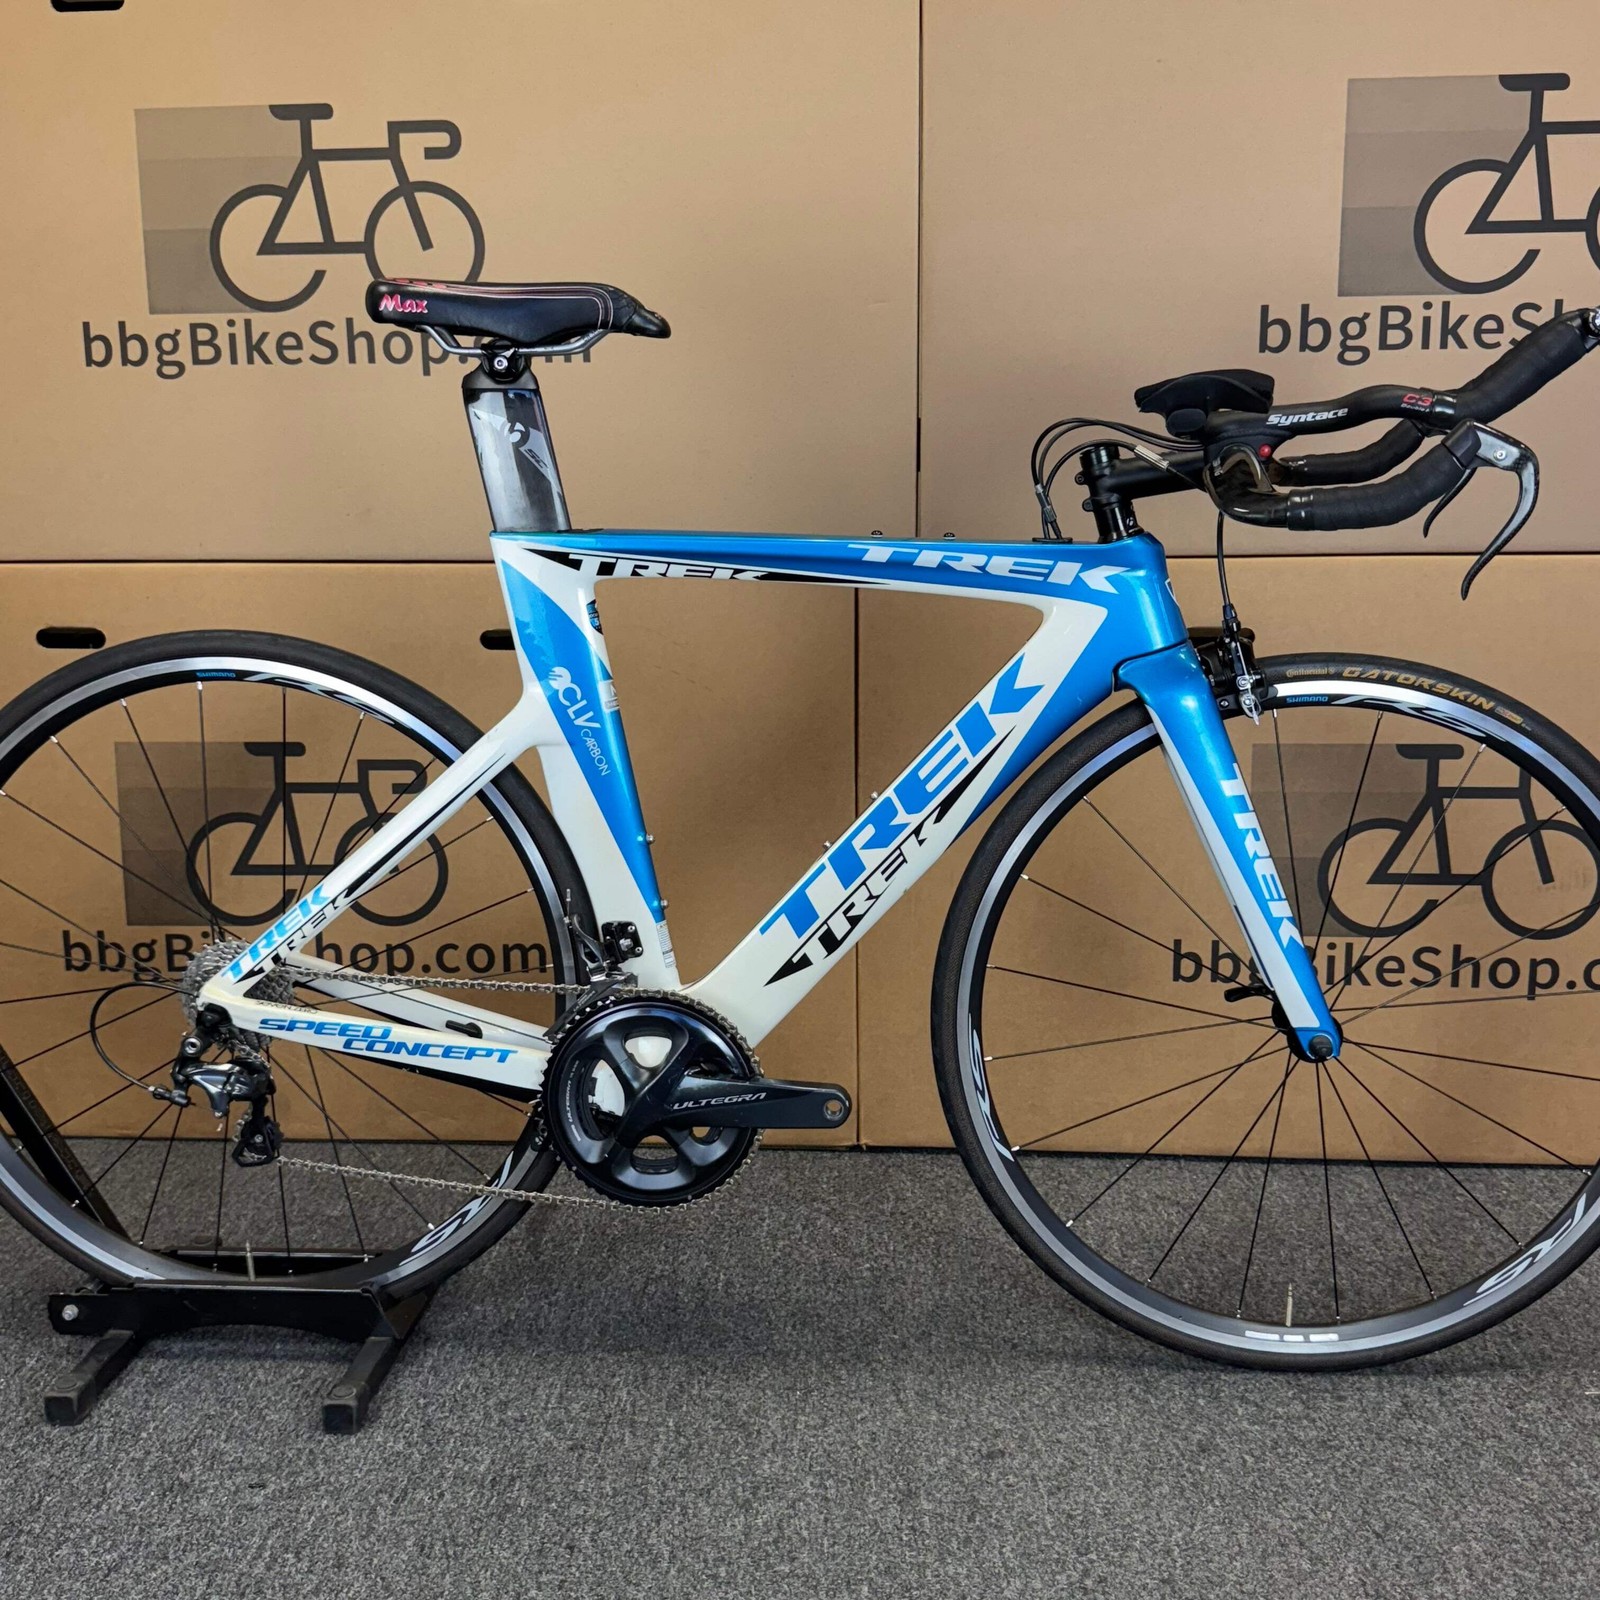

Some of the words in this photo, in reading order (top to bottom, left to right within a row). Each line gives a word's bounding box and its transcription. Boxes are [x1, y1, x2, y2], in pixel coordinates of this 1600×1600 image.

[378, 293, 429, 314] Max
[1265, 406, 1350, 427] Syntace
[568, 553, 771, 581] TREK
[847, 543, 1132, 595] TREK
[1285, 695, 1329, 704] SHIMANO
[1341, 666, 1496, 711] GATORSKIN
[580, 727, 612, 777] CARBON
[758, 651, 1047, 940] TREK
[1220, 761, 1306, 949] TREK
[220, 882, 333, 980] TREK
[258, 1017, 393, 1040] SPEED
[341, 1037, 519, 1064] CONCEPT
[672, 1091, 768, 1110] ULTEGRA
